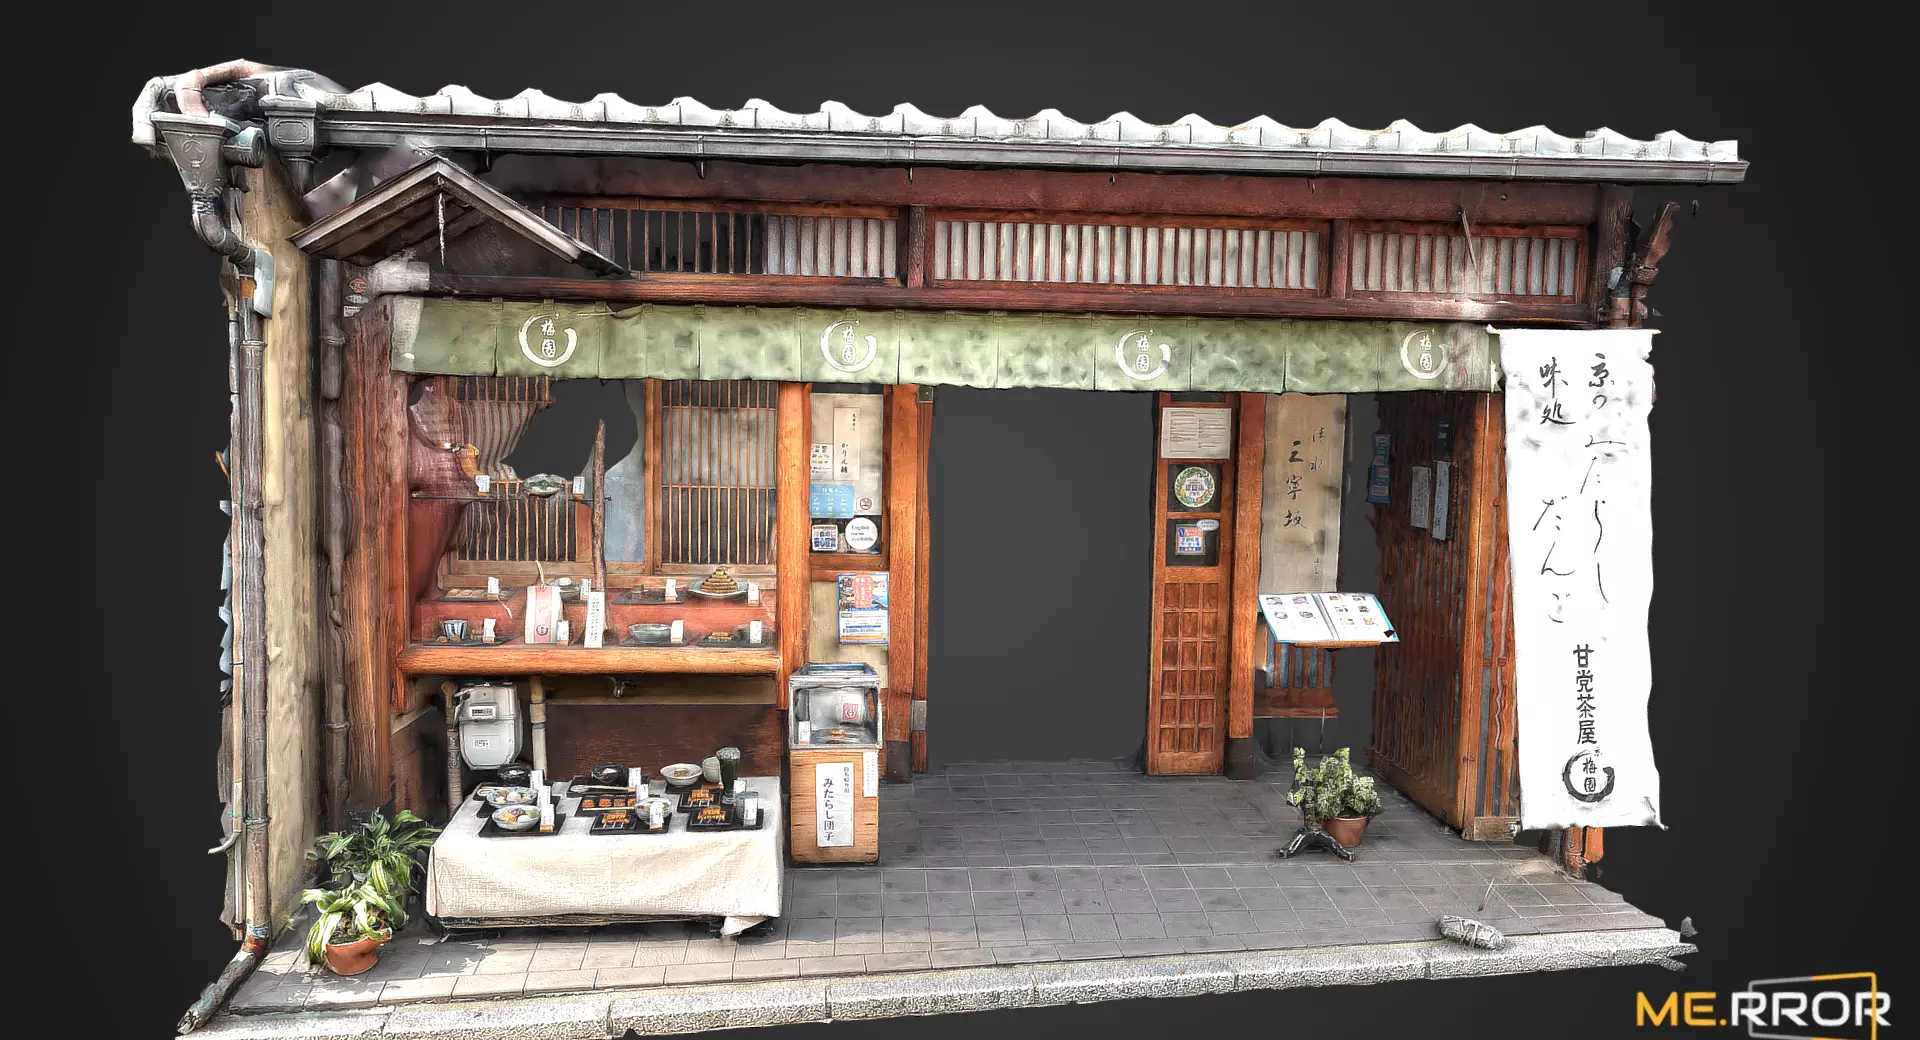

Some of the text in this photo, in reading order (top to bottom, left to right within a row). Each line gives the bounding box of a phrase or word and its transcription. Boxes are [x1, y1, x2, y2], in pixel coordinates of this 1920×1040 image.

[1539, 356, 1576, 425] 味処
[1572, 643, 1598, 745] 甘党茶屋
[1582, 756, 1598, 793] 梅園
[823, 778, 835, 842] みたらし団子
